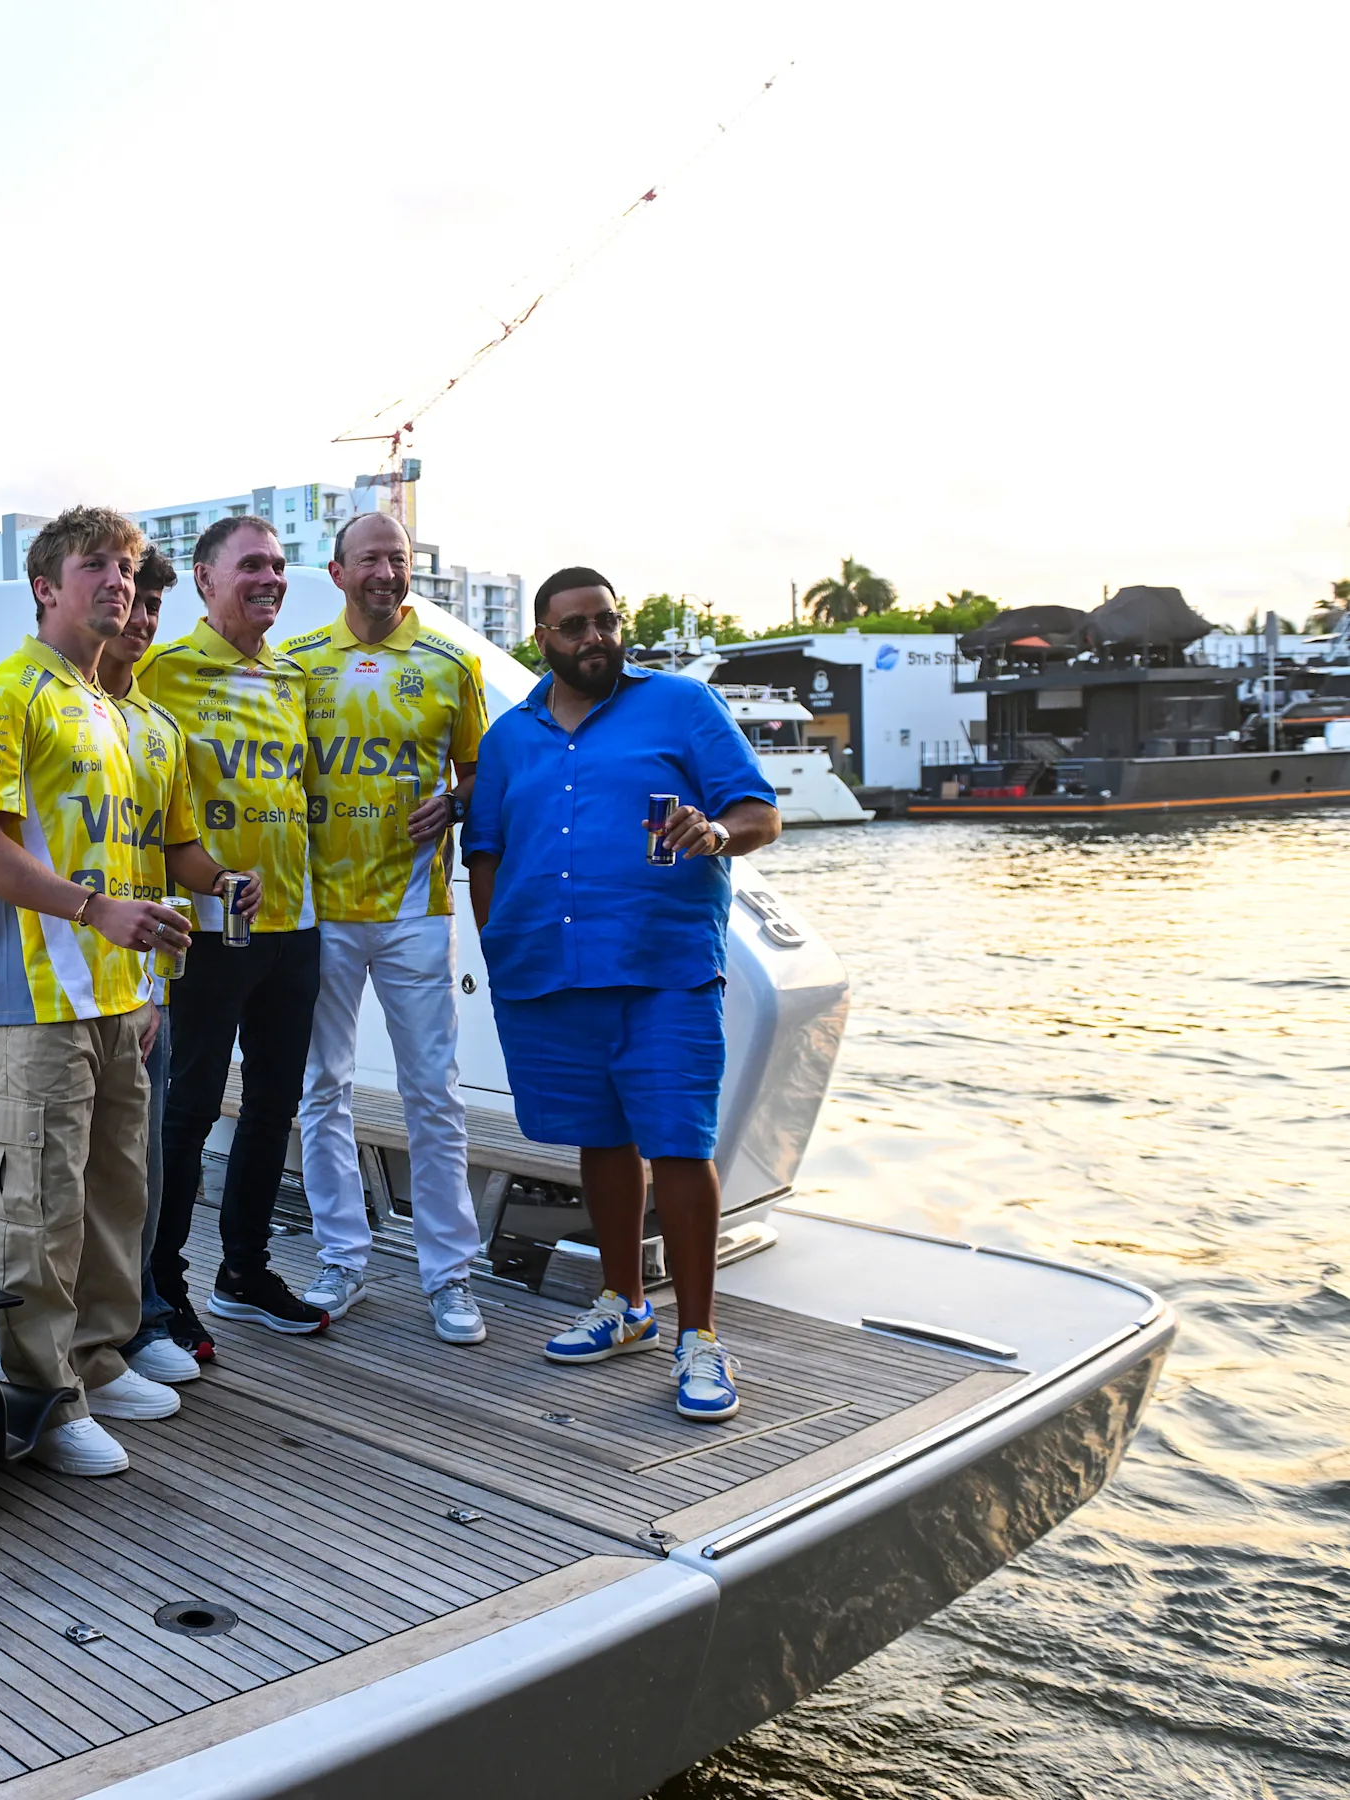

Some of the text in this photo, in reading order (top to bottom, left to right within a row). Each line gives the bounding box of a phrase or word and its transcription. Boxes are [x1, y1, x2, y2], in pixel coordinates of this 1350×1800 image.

[289, 631, 324, 647] HUGO
[425, 634, 464, 656] HUGO
[907, 651, 930, 665] 5TH
[18, 664, 37, 688] HUGO
[307, 697, 336, 705] TUDOR
[198, 711, 232, 722] Mobil
[306, 709, 335, 719] Mobil
[147, 727, 162, 737] VISA
[71, 744, 99, 753] TUDOR
[199, 738, 303, 782] VISA
[307, 736, 420, 777] VISA
[72, 760, 102, 773] Mobil
[243, 806, 286, 823] Cash
[334, 801, 380, 818] Cash
